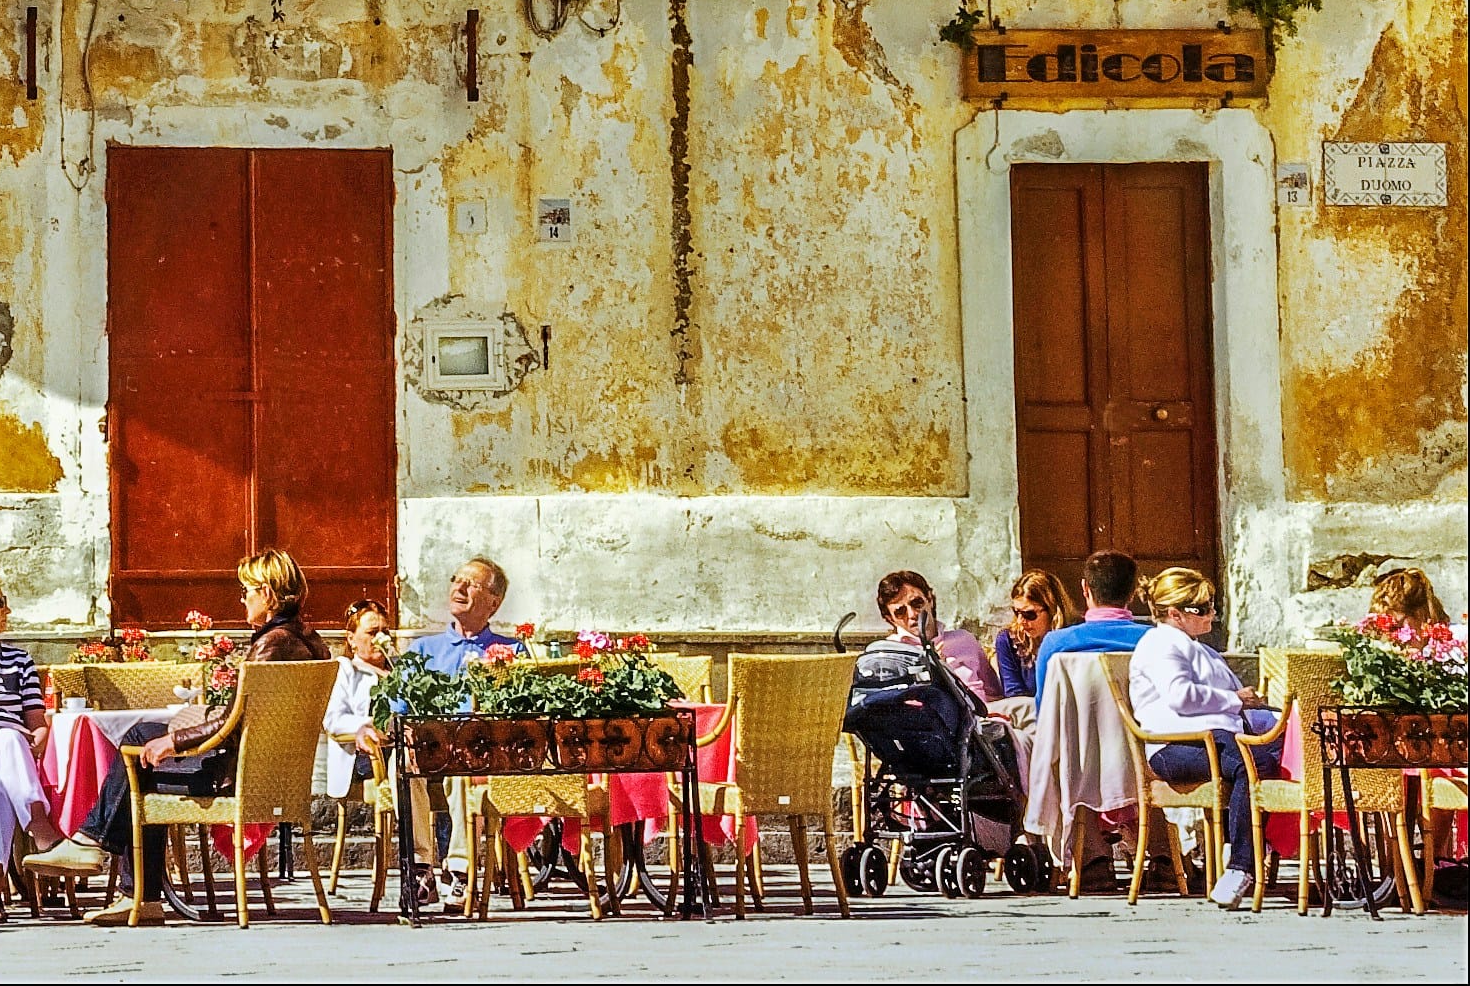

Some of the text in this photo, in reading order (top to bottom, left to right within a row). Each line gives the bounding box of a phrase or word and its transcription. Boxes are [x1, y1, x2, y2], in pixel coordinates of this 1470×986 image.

[978, 44, 1255, 83] Edicola
[1357, 156, 1416, 169] PIAZZA
[1361, 179, 1412, 191] DUOMO
[1287, 190, 1298, 203] 13
[549, 226, 559, 239] 14
